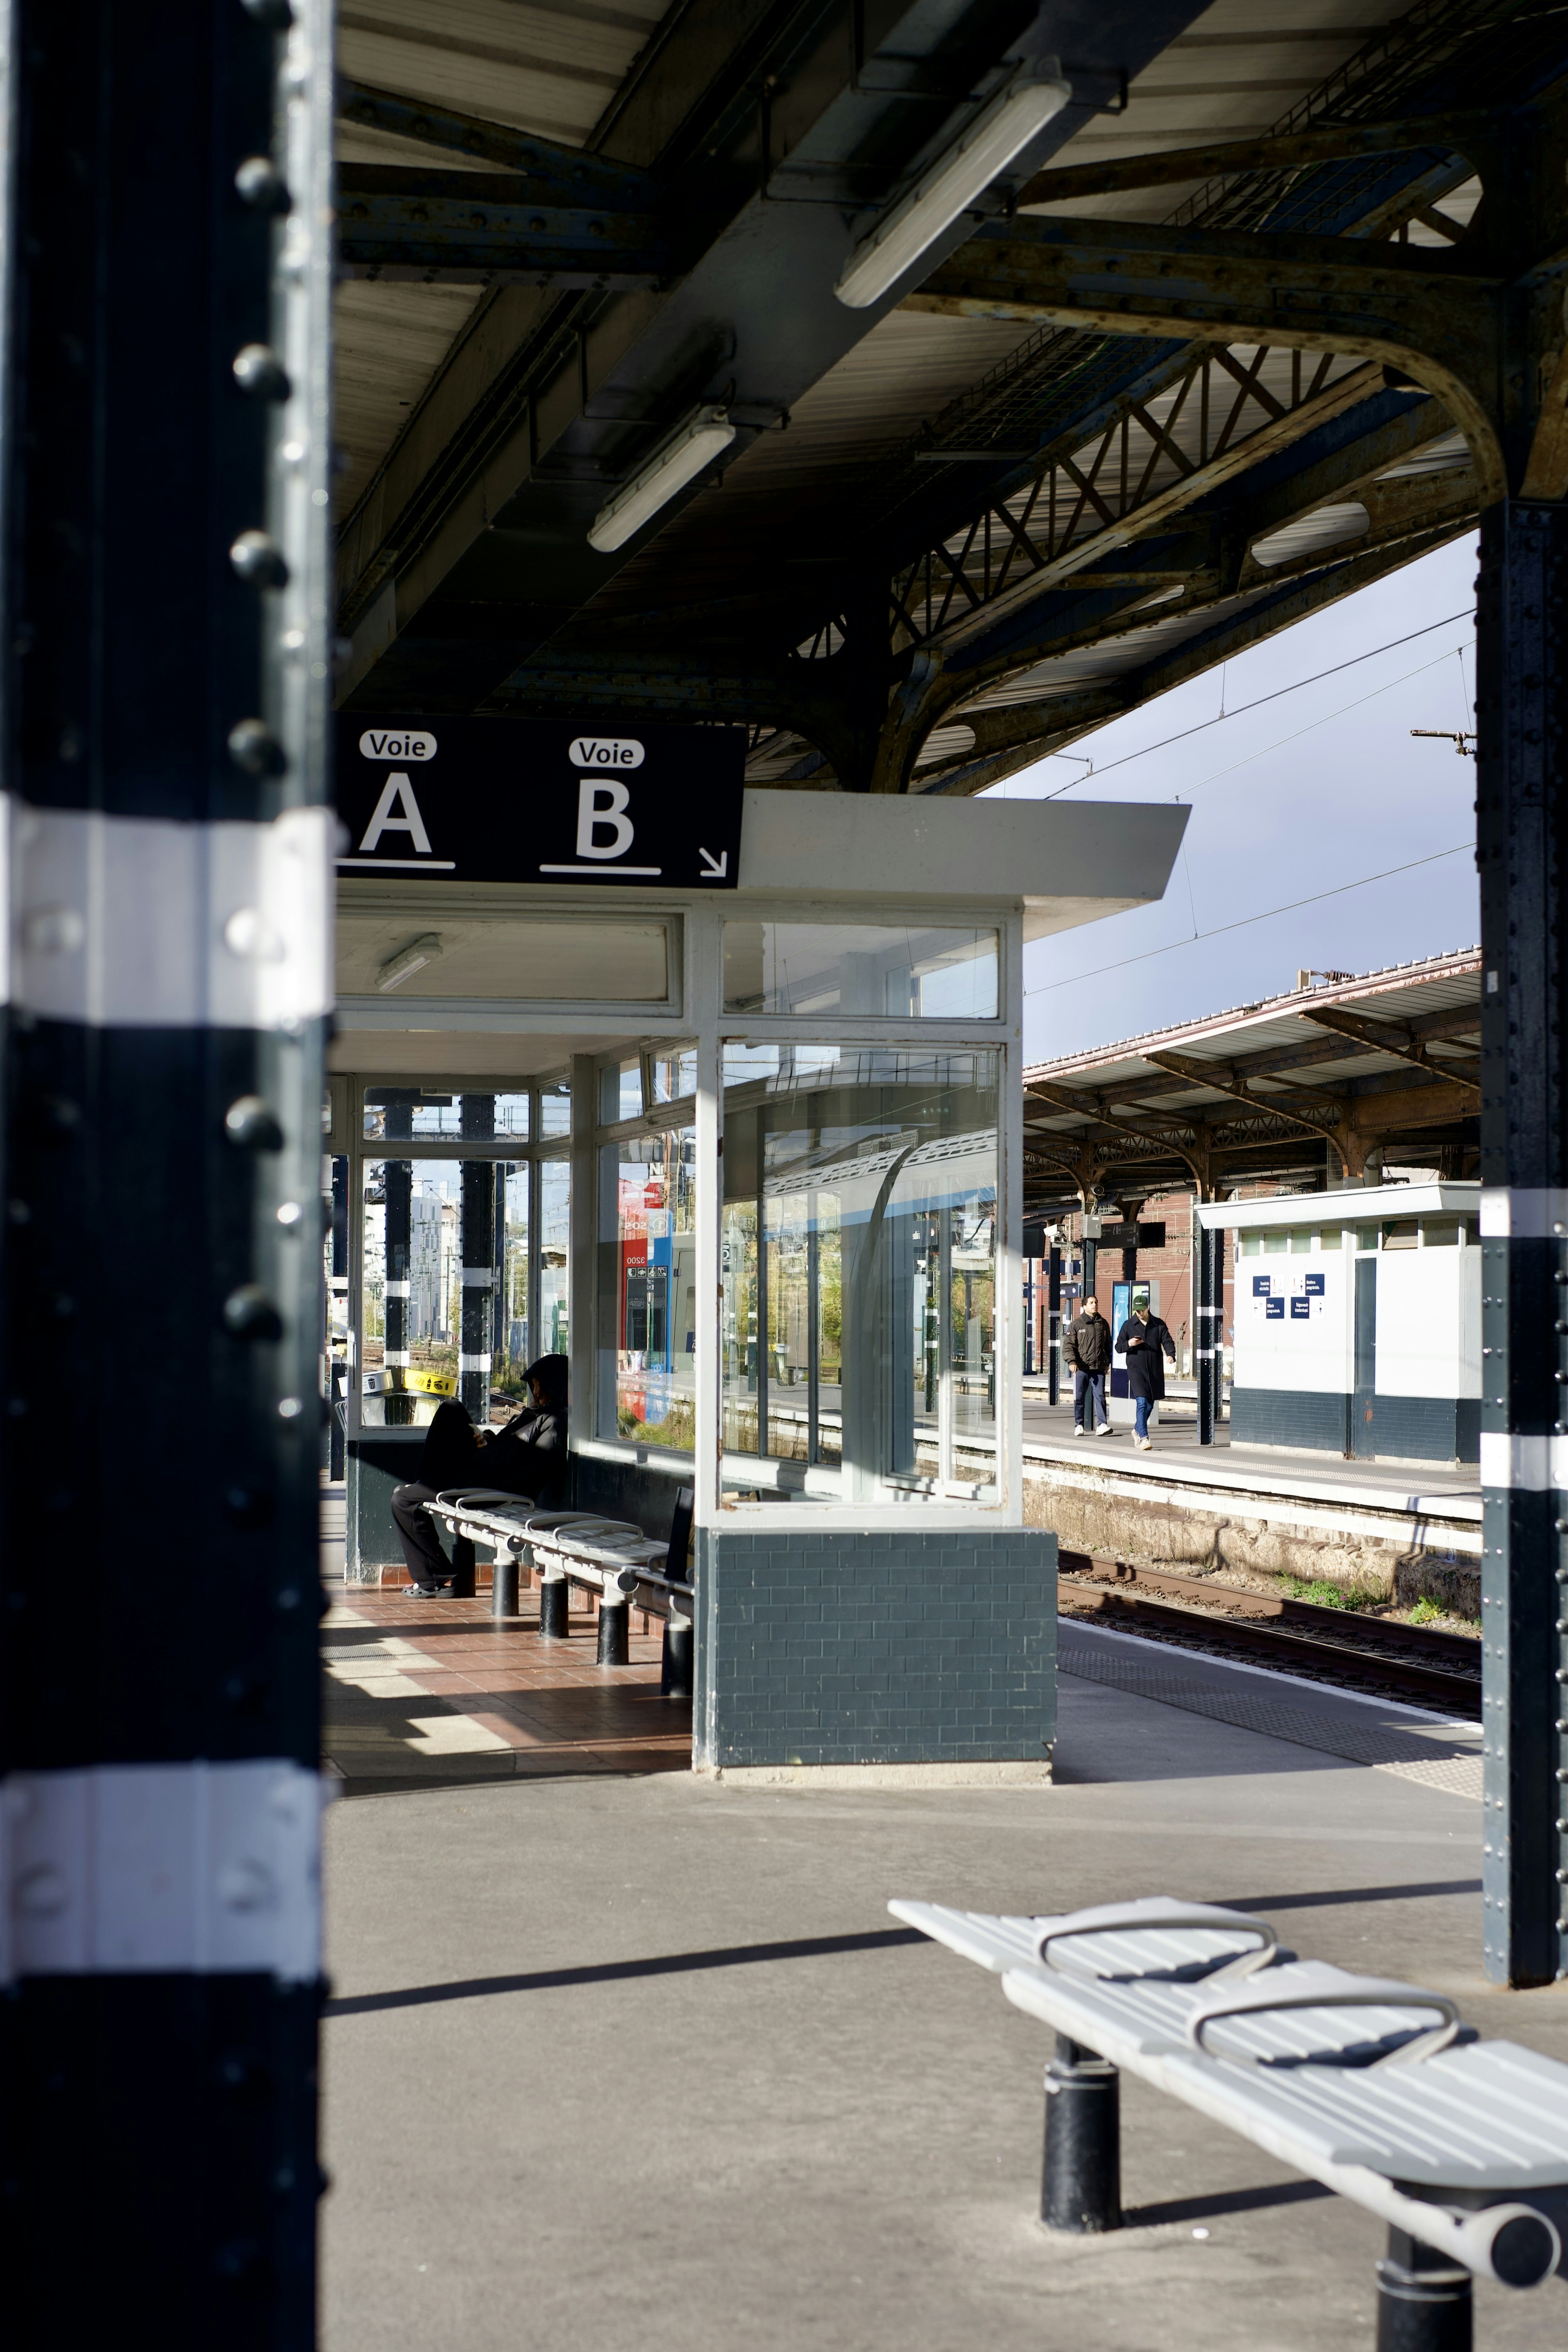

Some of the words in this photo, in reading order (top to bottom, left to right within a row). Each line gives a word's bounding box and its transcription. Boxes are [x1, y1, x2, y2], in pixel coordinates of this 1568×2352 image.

[370, 734, 425, 756] Voie
[579, 742, 633, 764] Voie
[359, 773, 431, 852] A
[577, 779, 633, 858] B
